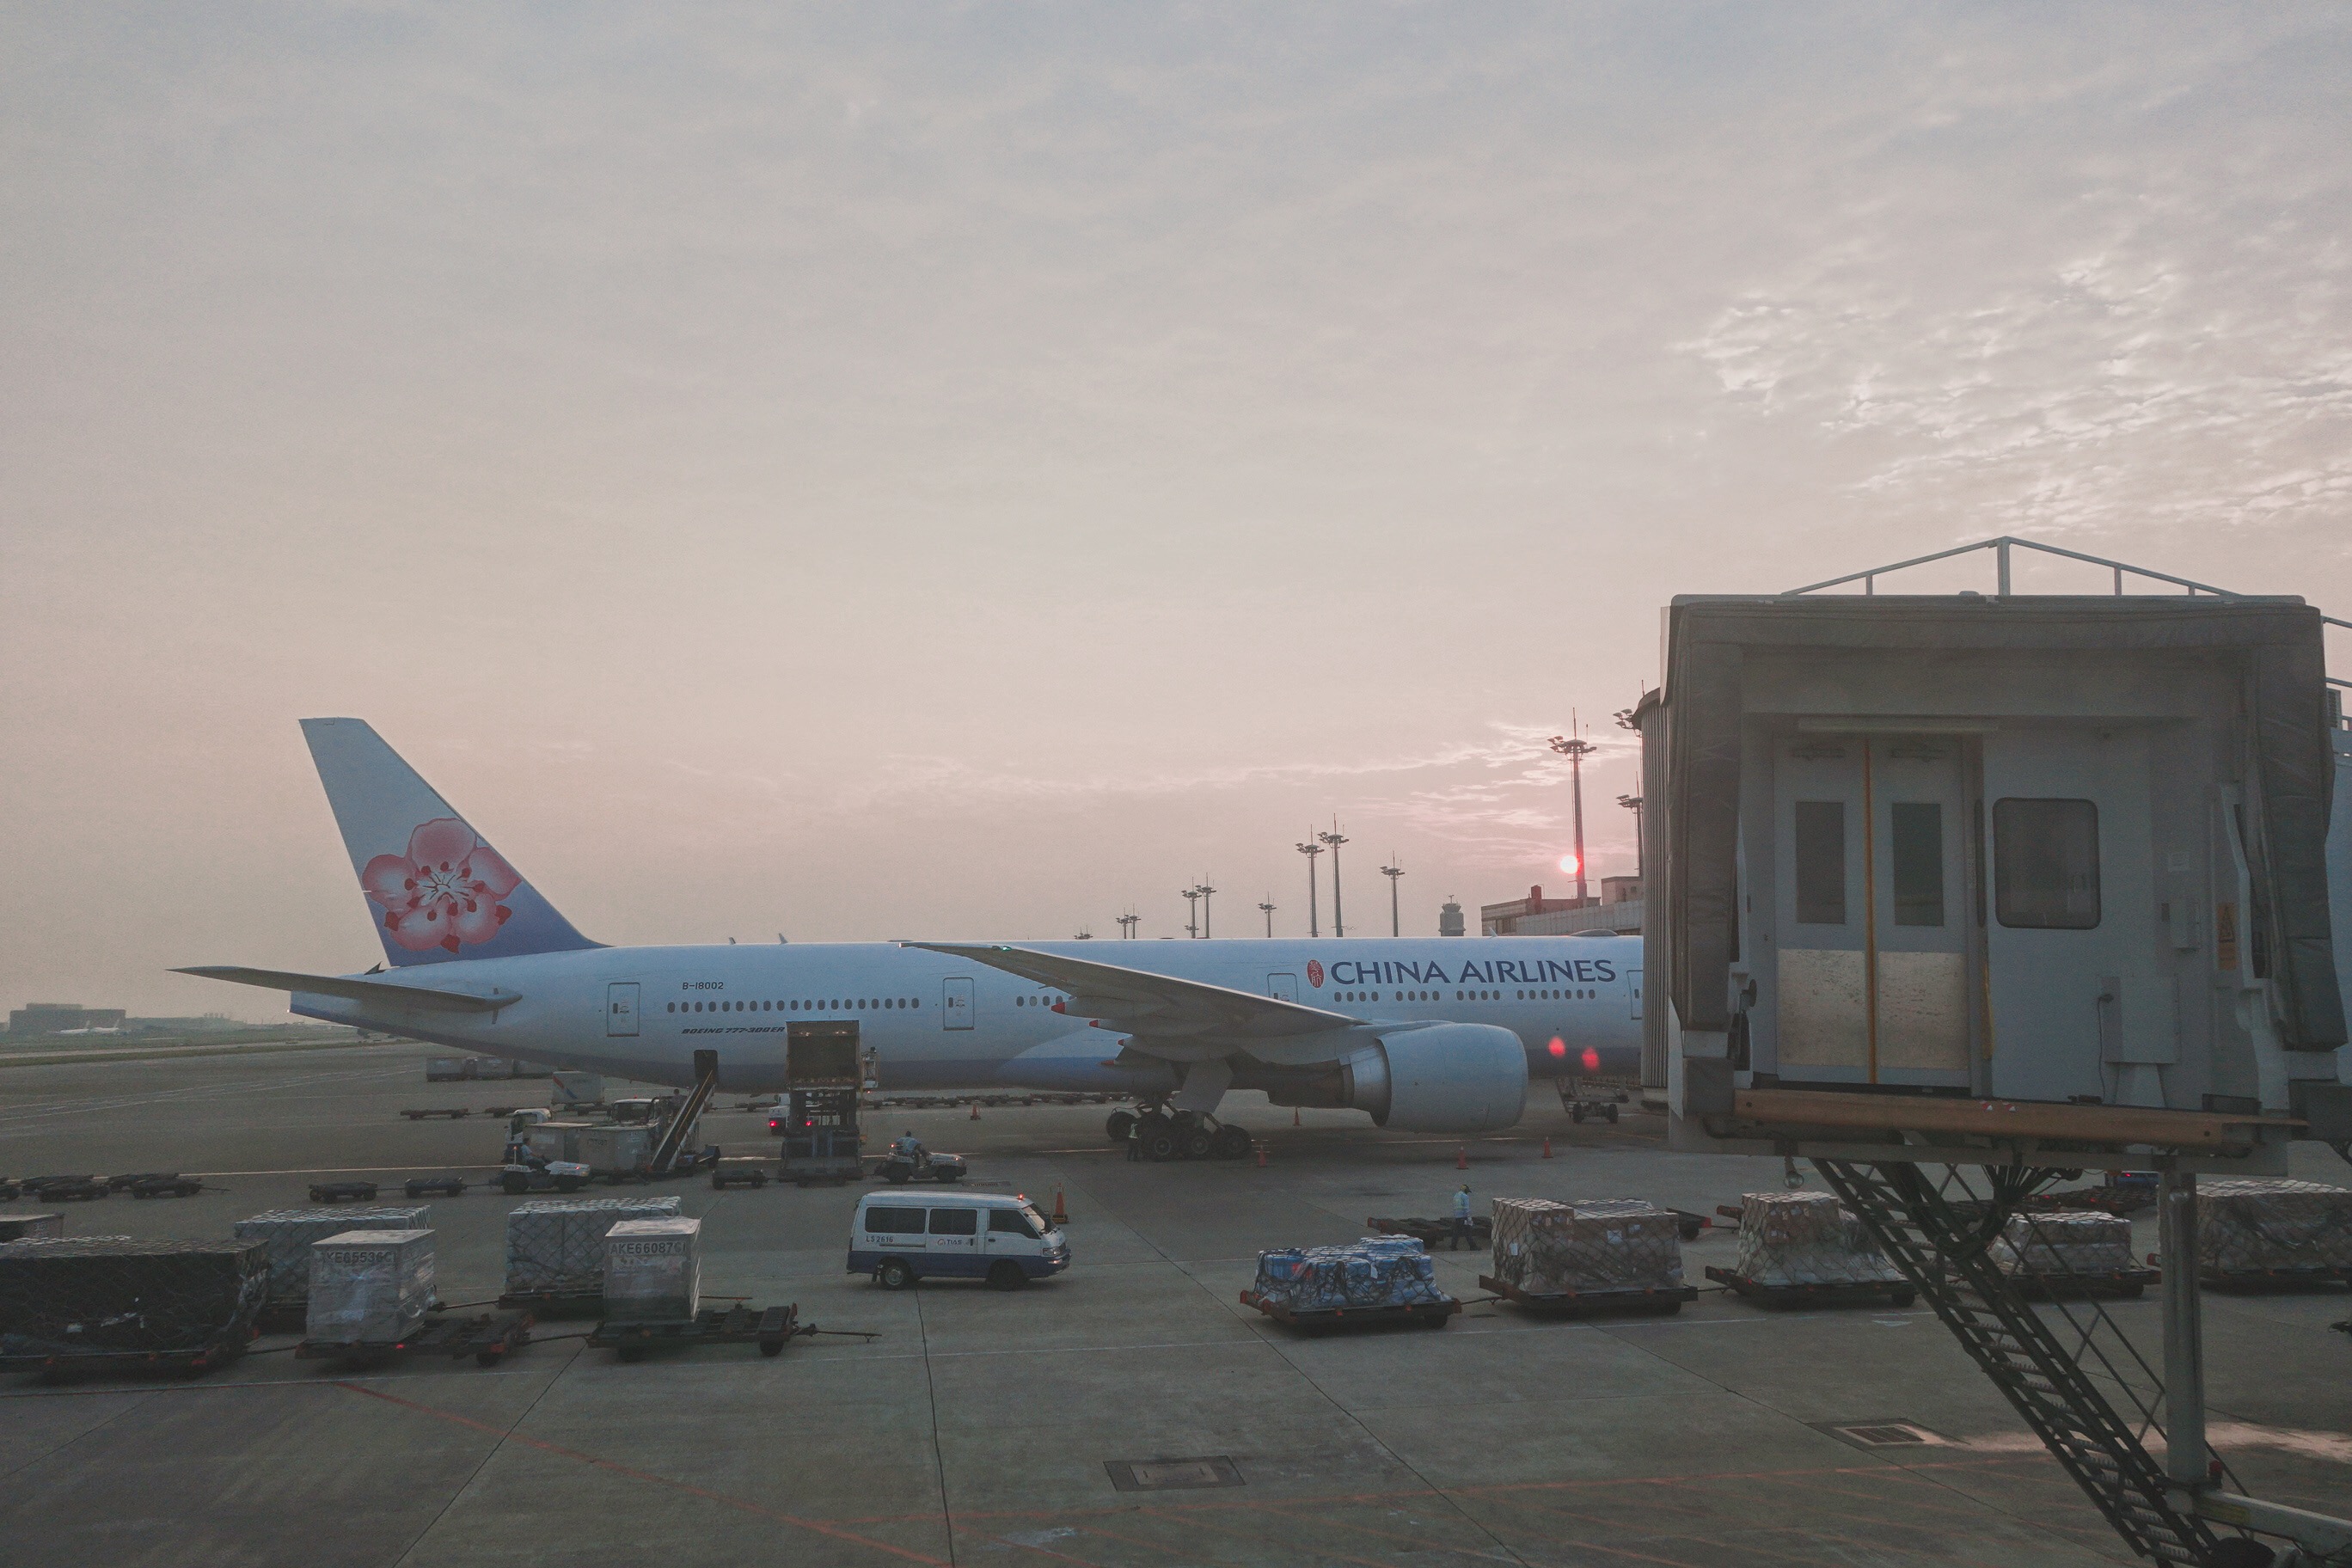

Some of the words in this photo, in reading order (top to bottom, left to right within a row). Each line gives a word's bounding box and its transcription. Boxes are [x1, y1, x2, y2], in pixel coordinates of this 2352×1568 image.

[1331, 960, 1451, 984] CHINA
[1459, 959, 1616, 983] AIRLINES
[682, 982, 724, 990] B-18002
